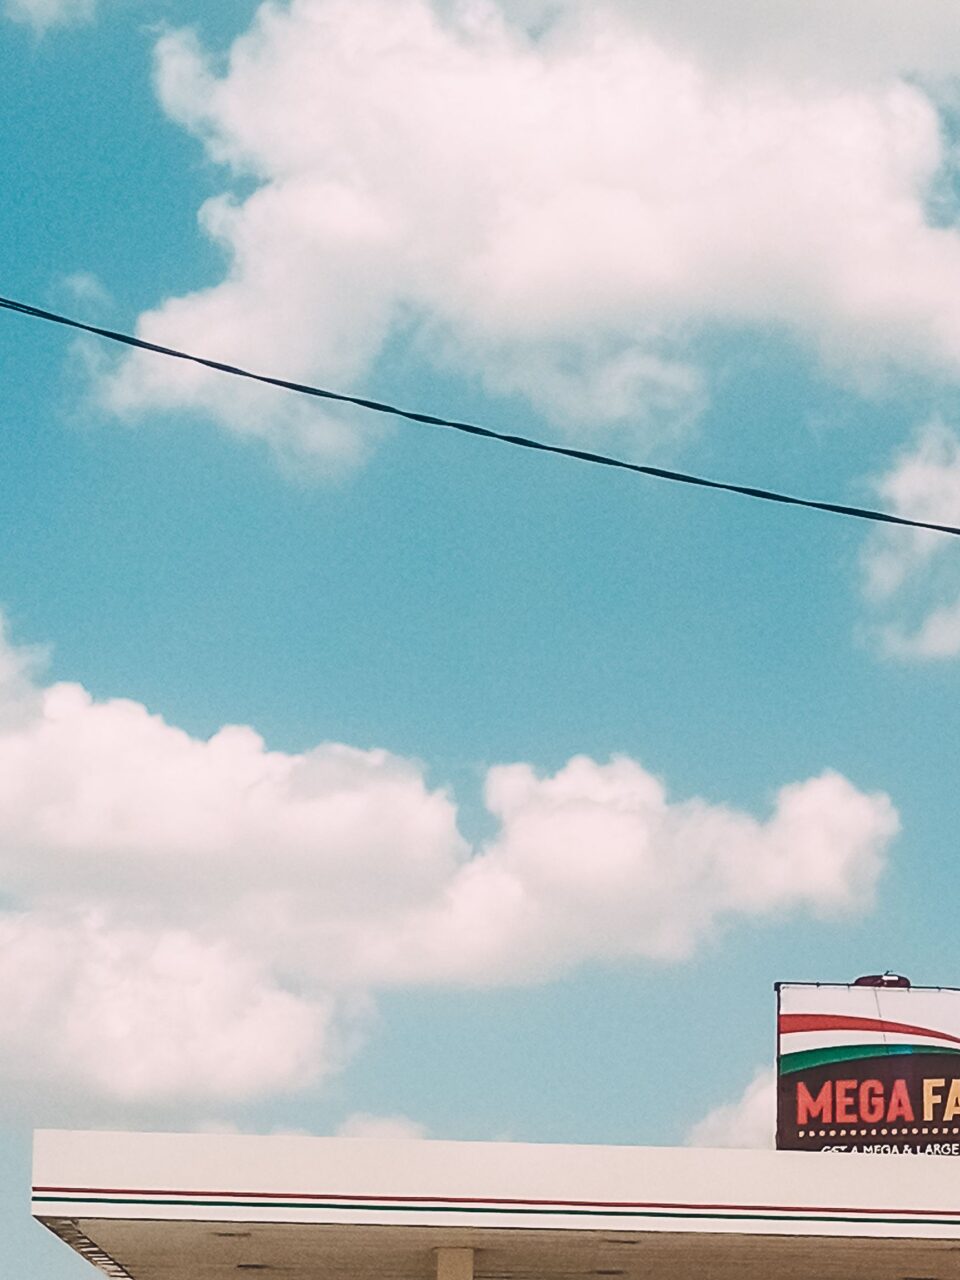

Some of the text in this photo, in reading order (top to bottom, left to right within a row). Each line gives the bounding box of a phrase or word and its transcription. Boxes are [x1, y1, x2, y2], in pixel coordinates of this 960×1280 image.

[796, 1079, 914, 1125] MEGA
[863, 1144, 900, 1155] MEGA
[916, 1143, 960, 1155] LARGE
